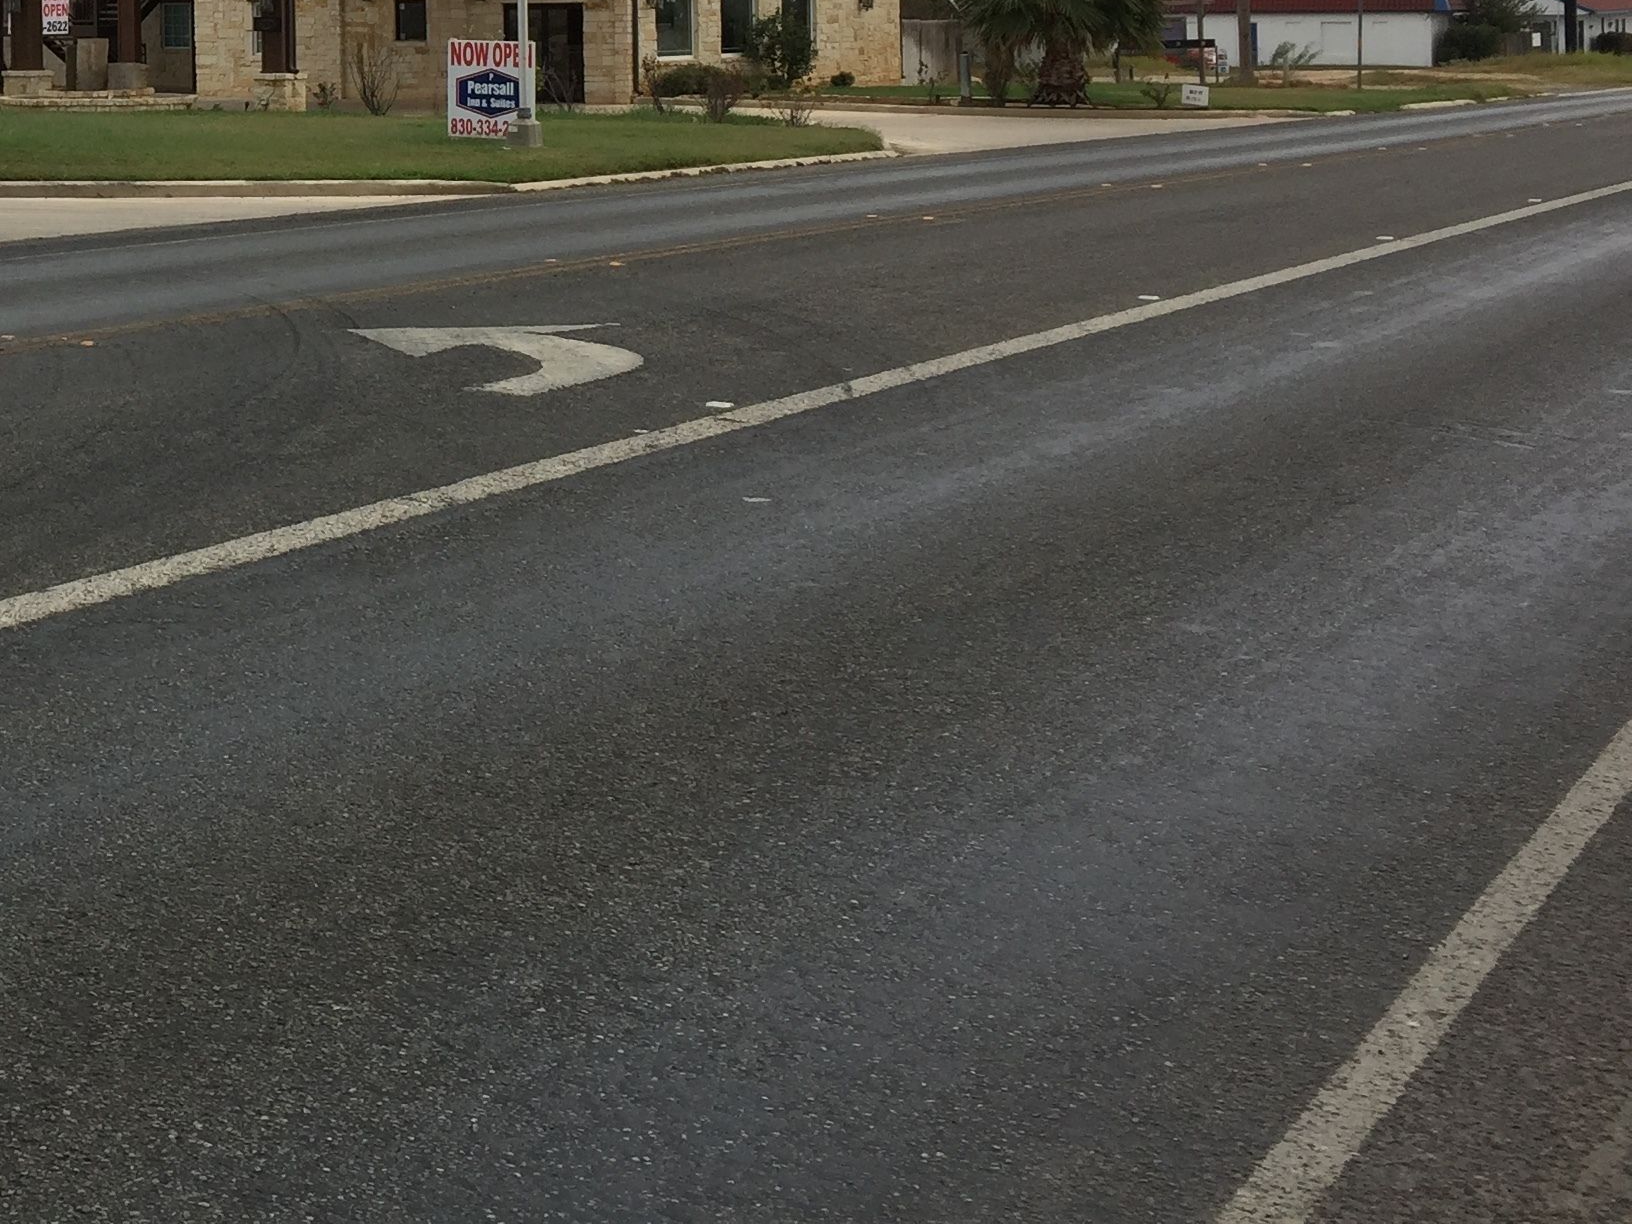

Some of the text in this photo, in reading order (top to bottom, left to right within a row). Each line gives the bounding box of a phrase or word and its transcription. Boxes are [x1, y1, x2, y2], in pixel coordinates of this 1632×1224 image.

[43, 4, 68, 17] OPEN
[450, 42, 489, 66] NOW
[467, 81, 514, 95] Pearsall
[467, 97, 516, 109] Inn & Suites
[451, 118, 509, 136] 830-334-2
